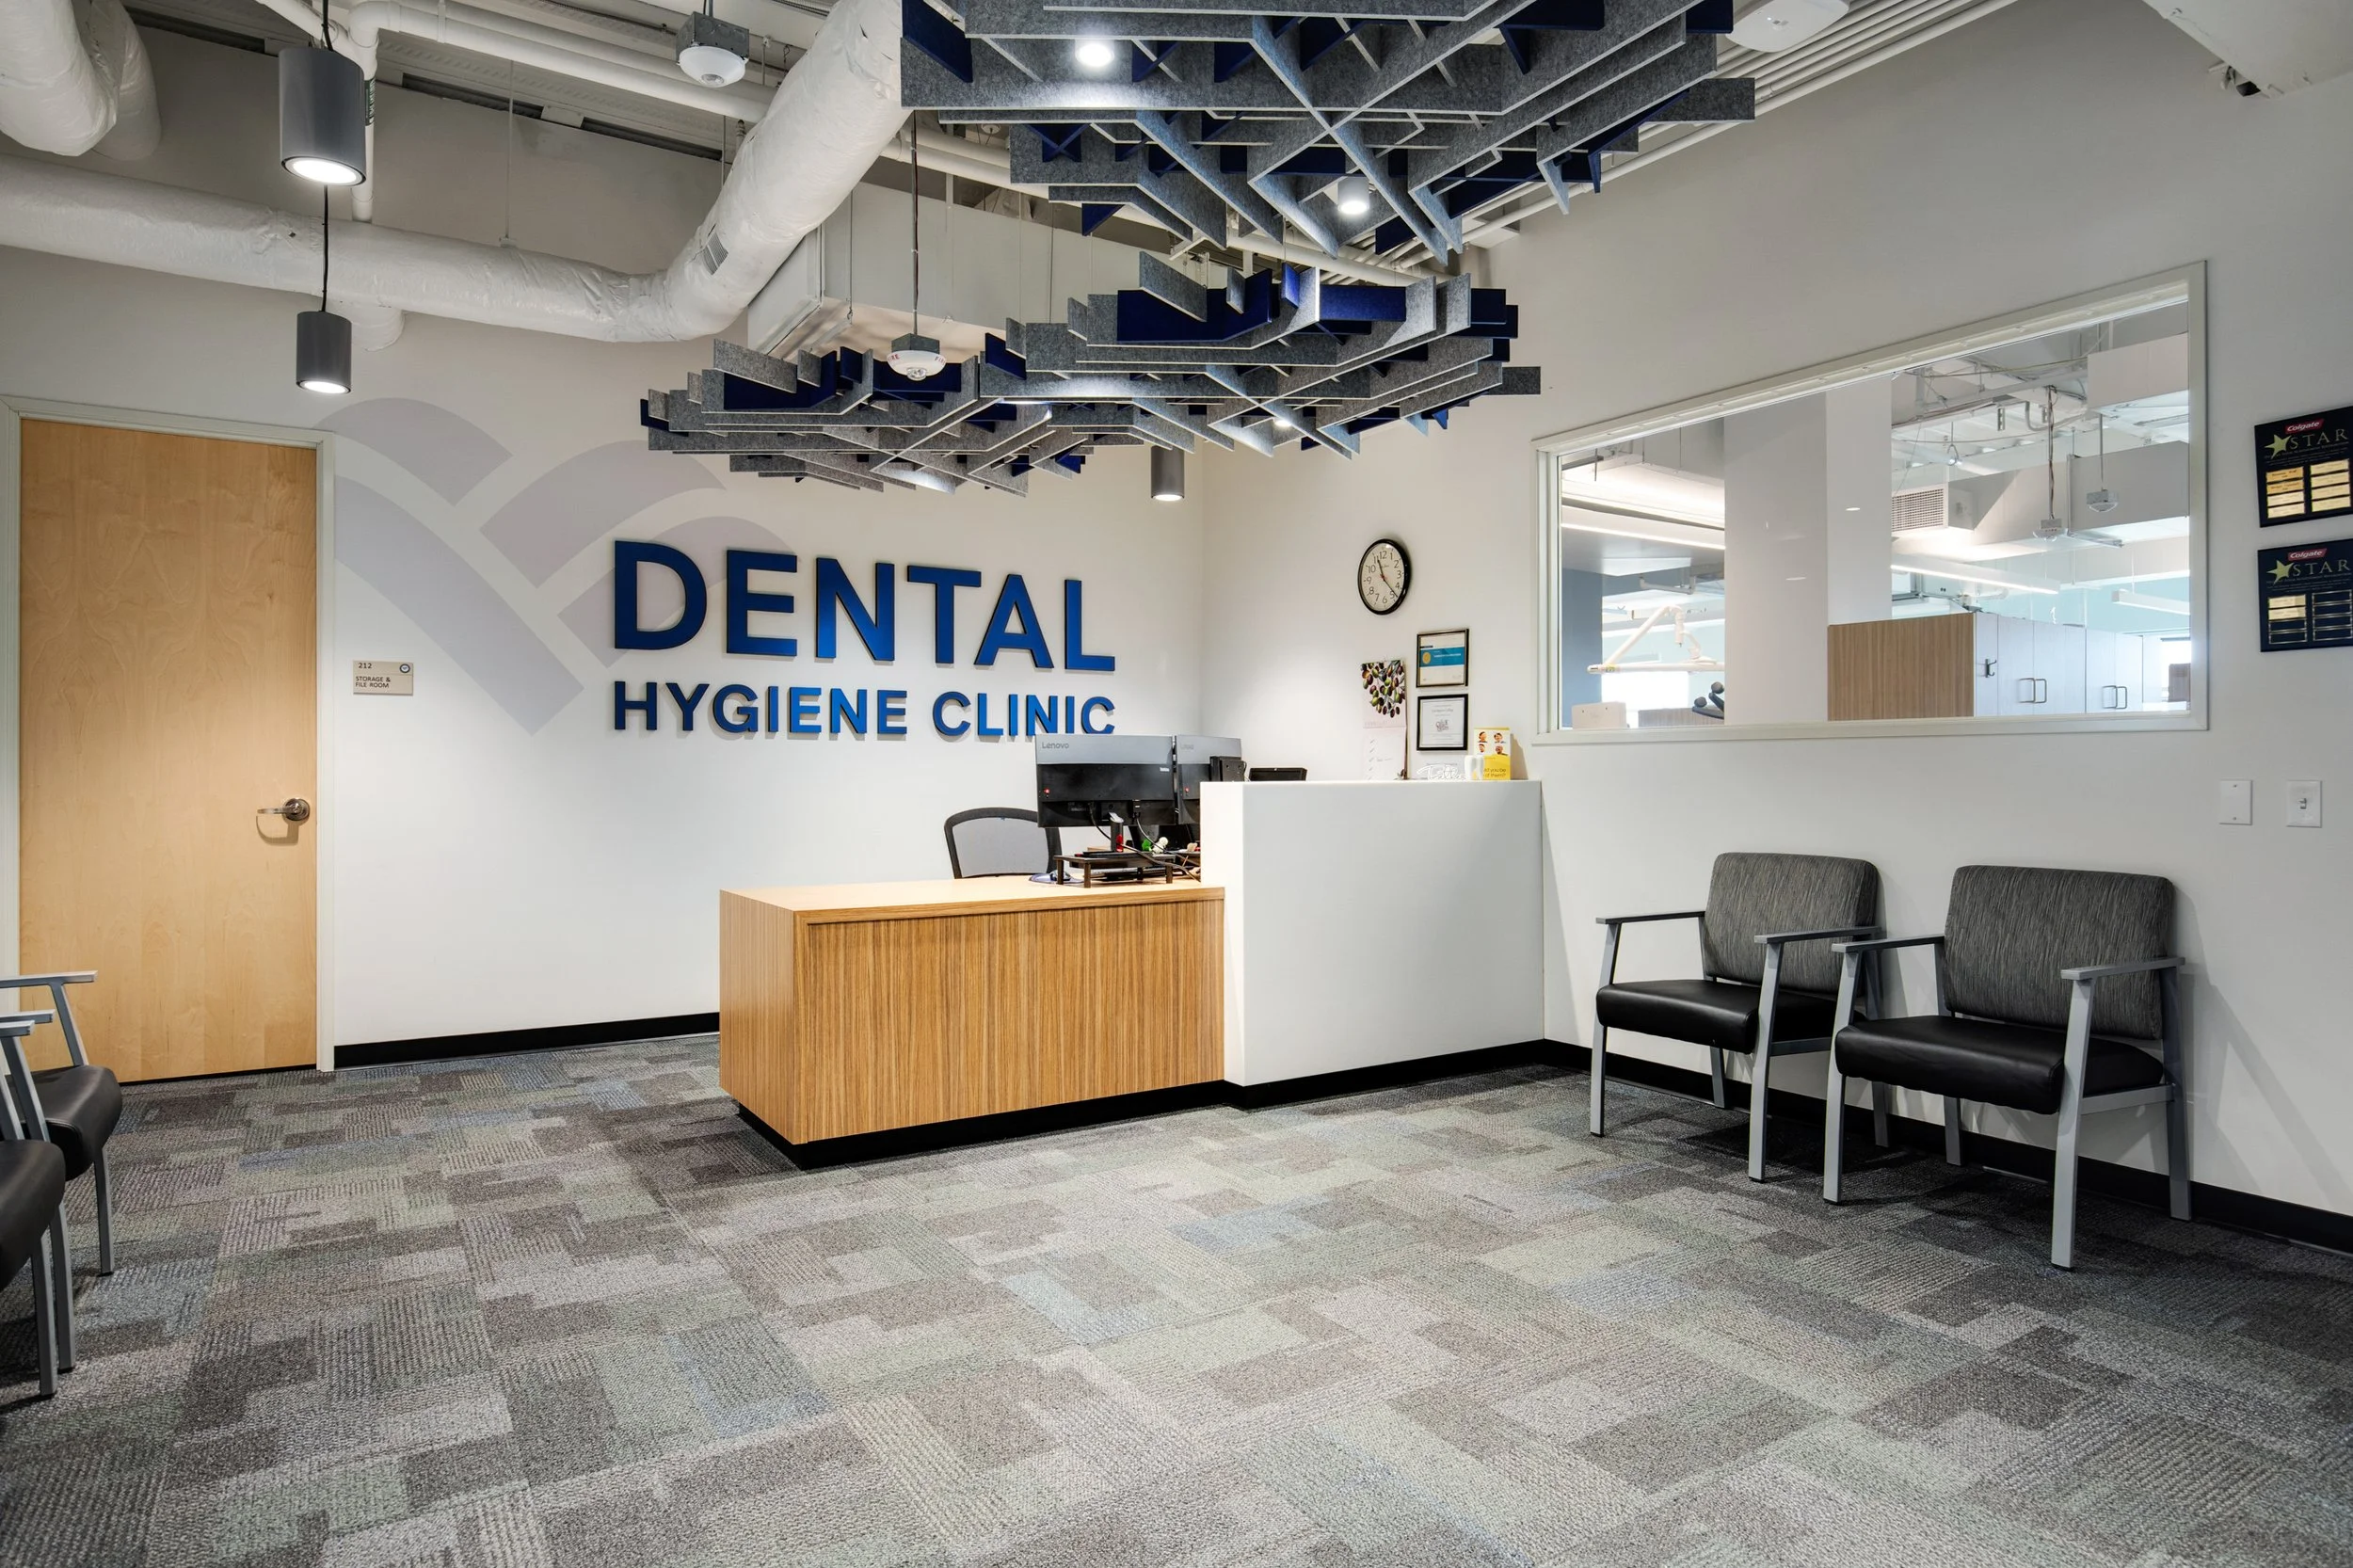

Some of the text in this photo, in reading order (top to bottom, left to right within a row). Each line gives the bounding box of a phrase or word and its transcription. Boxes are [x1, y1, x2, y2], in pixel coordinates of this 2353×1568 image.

[2286, 421, 2320, 432] Colgate
[2290, 428, 2349, 450] STAR
[1379, 551, 1387, 559] 12
[2290, 550, 2323, 558] Colgate
[1394, 560, 1399, 568] 2
[2292, 559, 2350, 577] STAR
[1368, 565, 1376, 573] 10
[1397, 570, 1401, 579] 3
[1369, 586, 1374, 595] 8
[1375, 593, 1380, 601] 7
[614, 539, 1116, 672] DENTAL
[614, 680, 1115, 736] HYGIENE CLINIC
